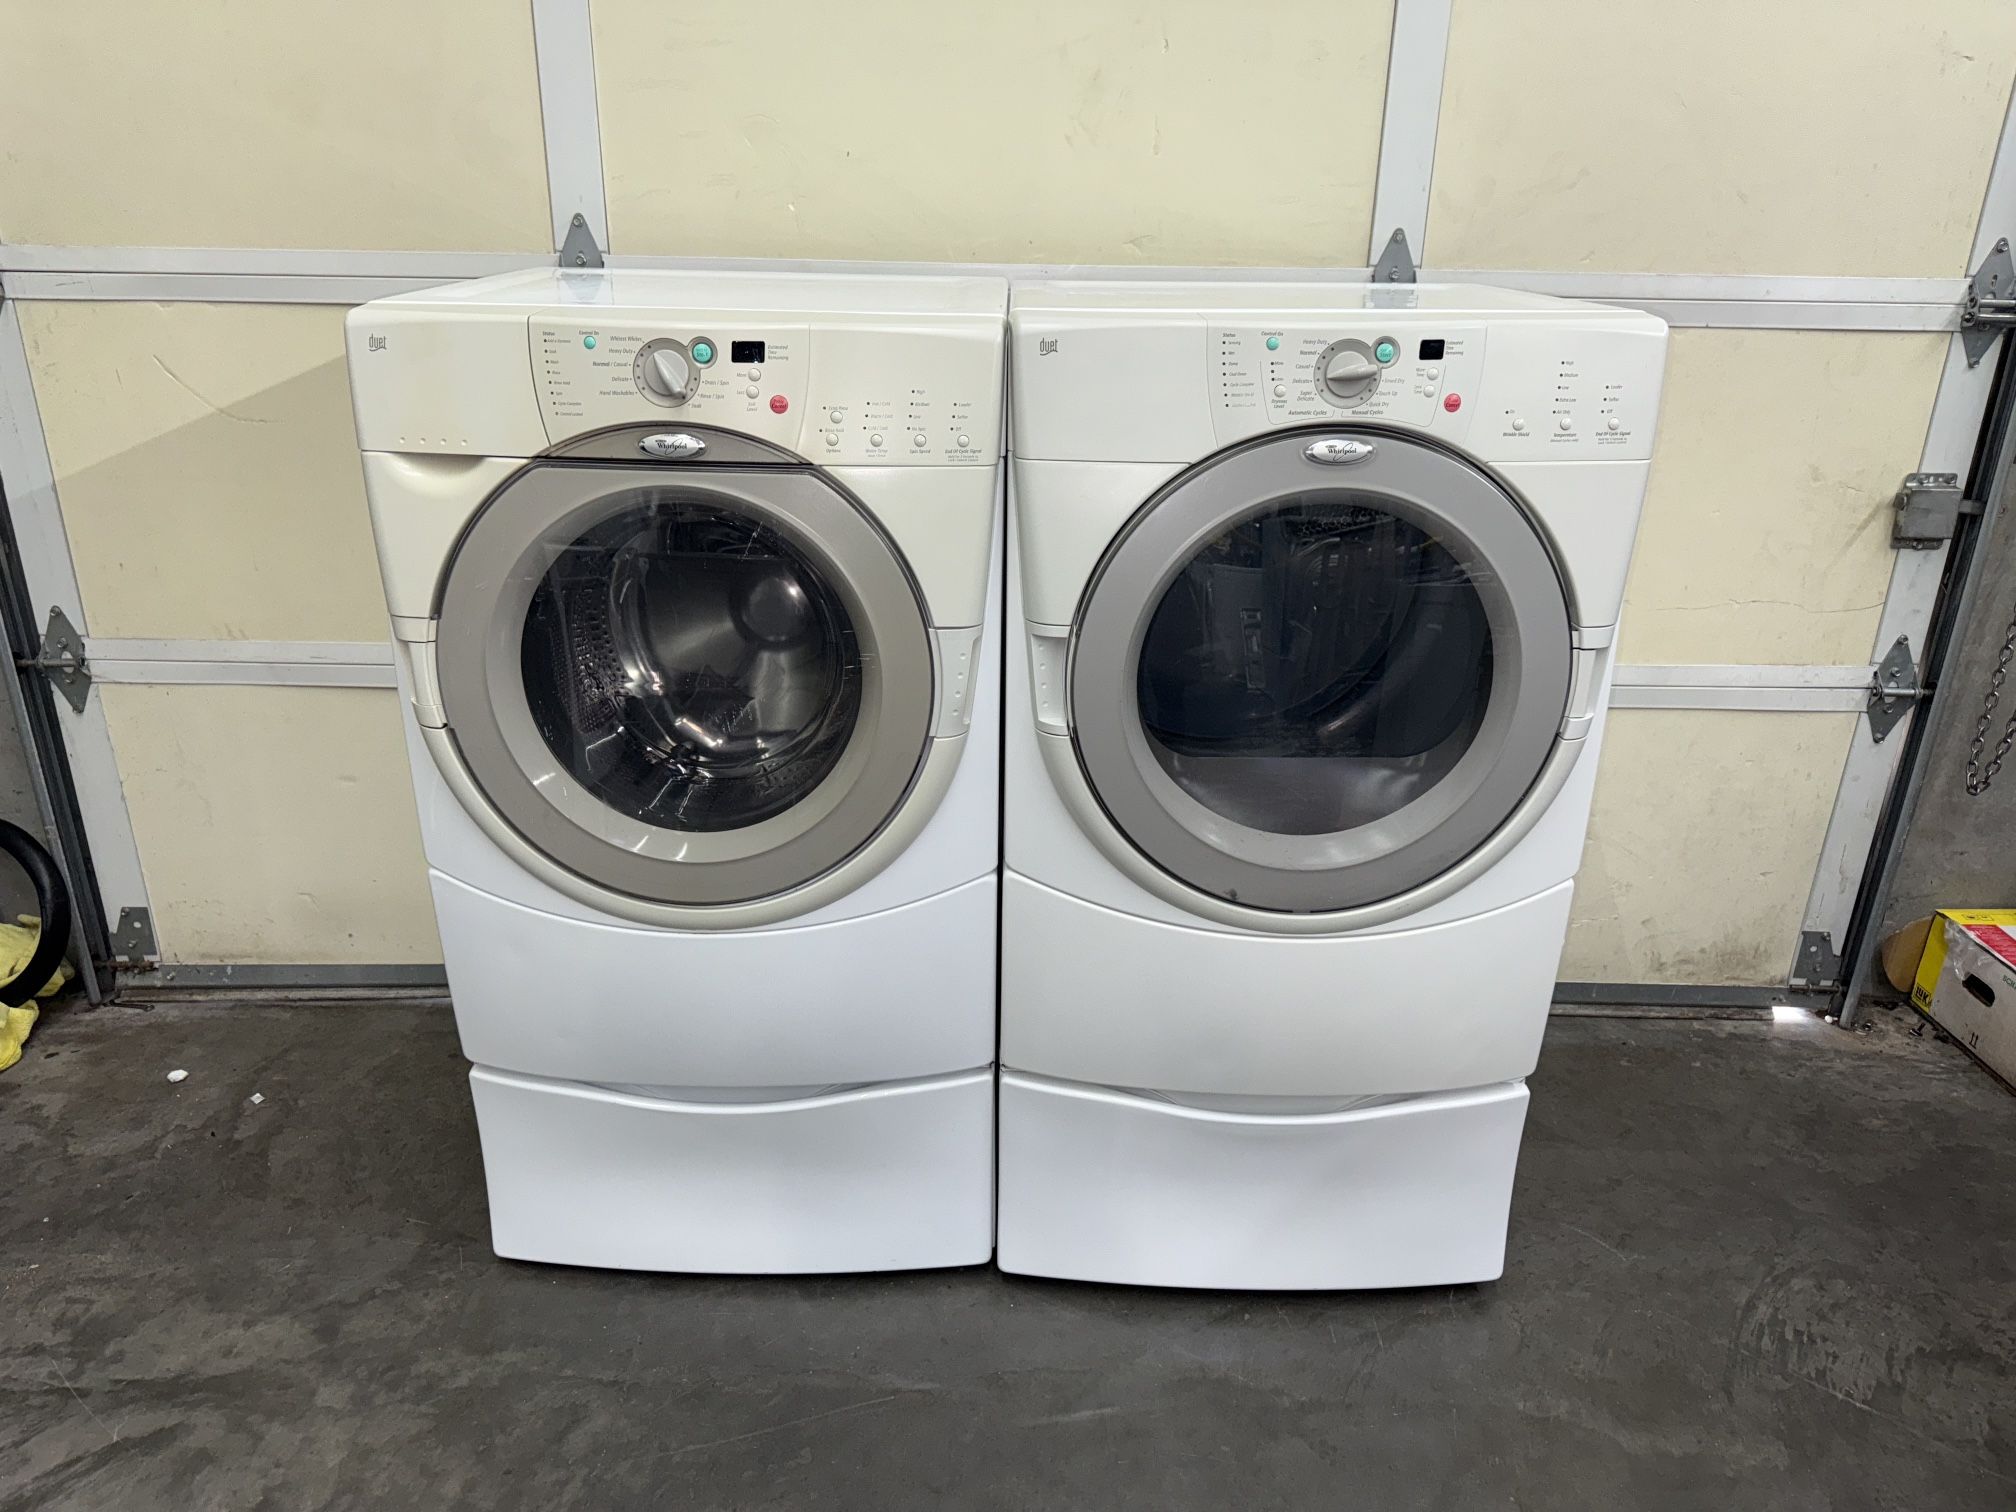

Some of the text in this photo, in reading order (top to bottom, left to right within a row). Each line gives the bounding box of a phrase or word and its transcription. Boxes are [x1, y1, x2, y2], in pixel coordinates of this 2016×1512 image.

[368, 332, 387, 351] duet
[1039, 337, 1058, 356] duet
[656, 442, 688, 450] Whirlpool
[1327, 447, 1357, 455] Whirlpool
